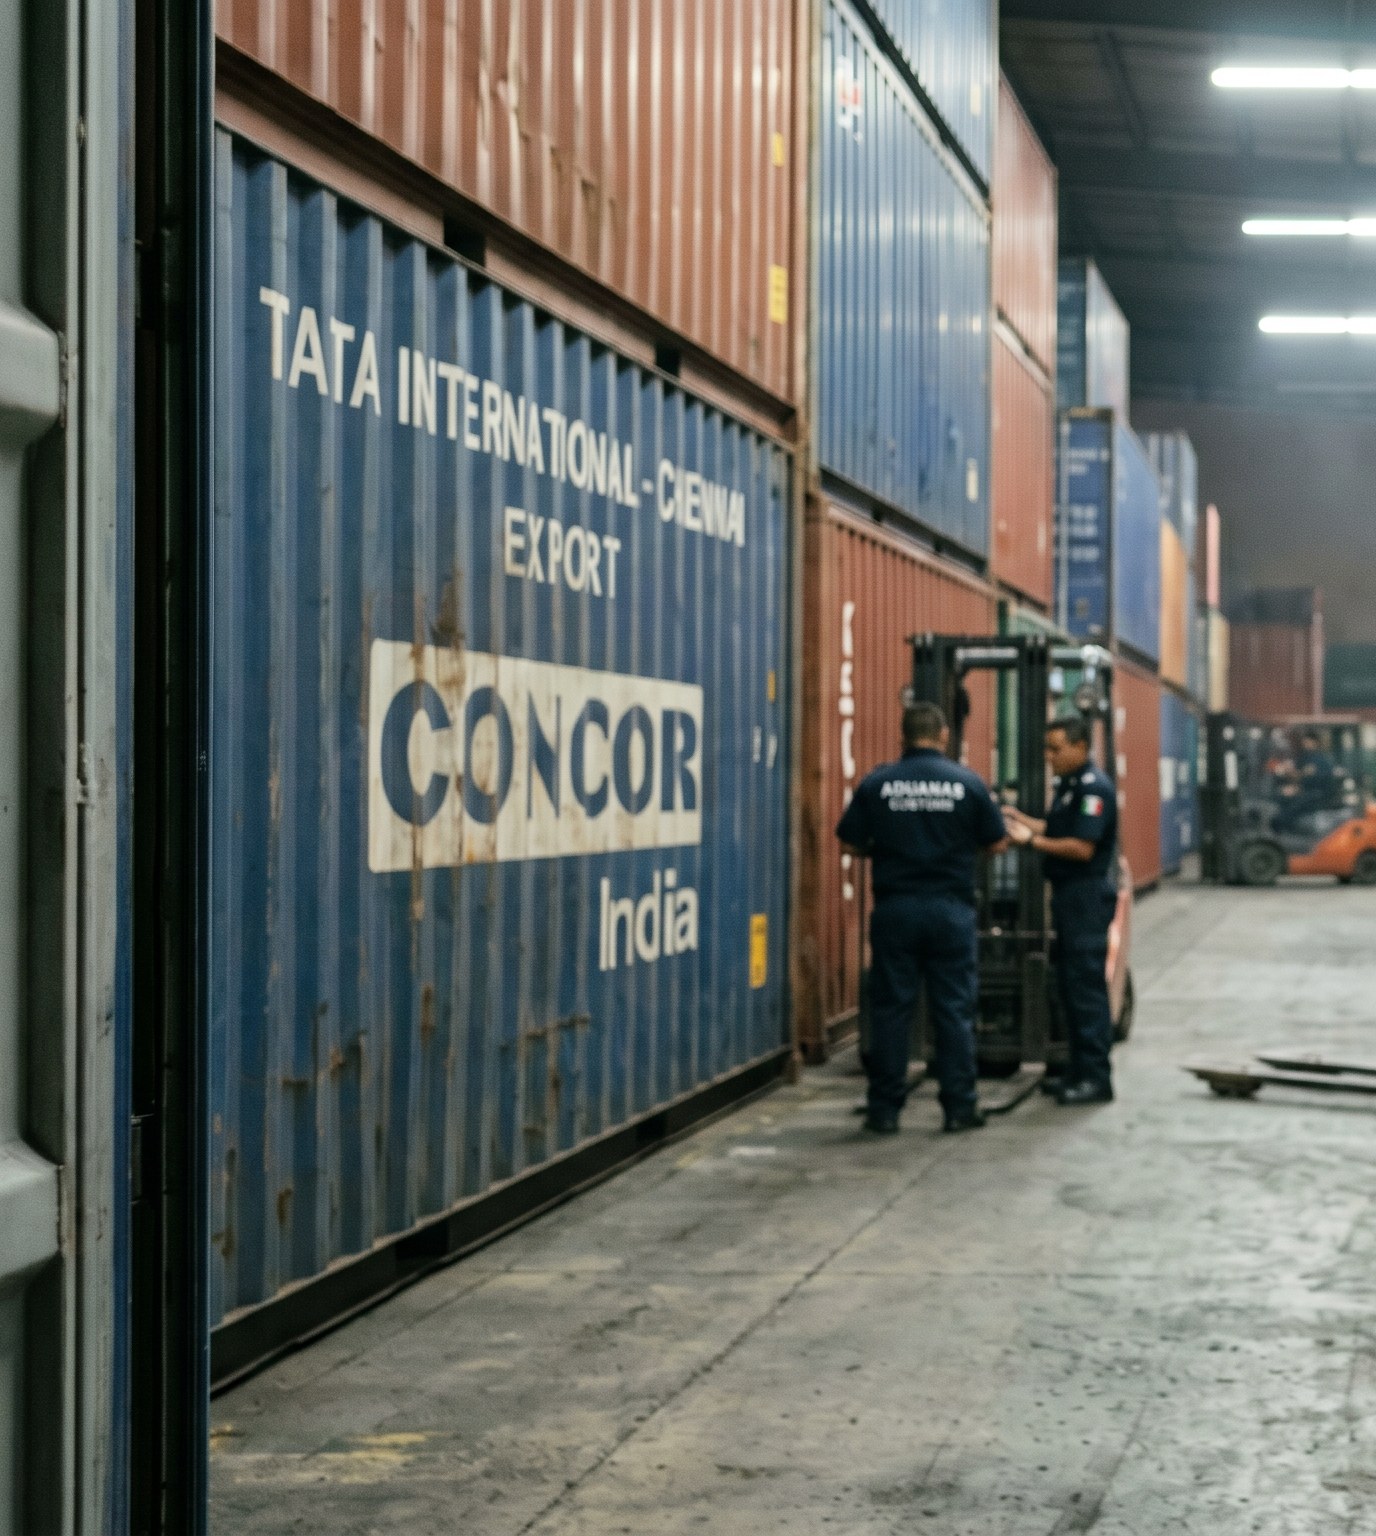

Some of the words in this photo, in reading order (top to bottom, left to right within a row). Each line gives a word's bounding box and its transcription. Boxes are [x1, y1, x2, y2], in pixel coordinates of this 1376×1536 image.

[260, 285, 381, 417] TATA
[398, 345, 640, 510] INTERNATIONAL
[504, 506, 621, 600] EXPORT
[381, 679, 698, 828] CONCOR
[880, 780, 965, 801] ADUANAS
[599, 868, 699, 971] India
